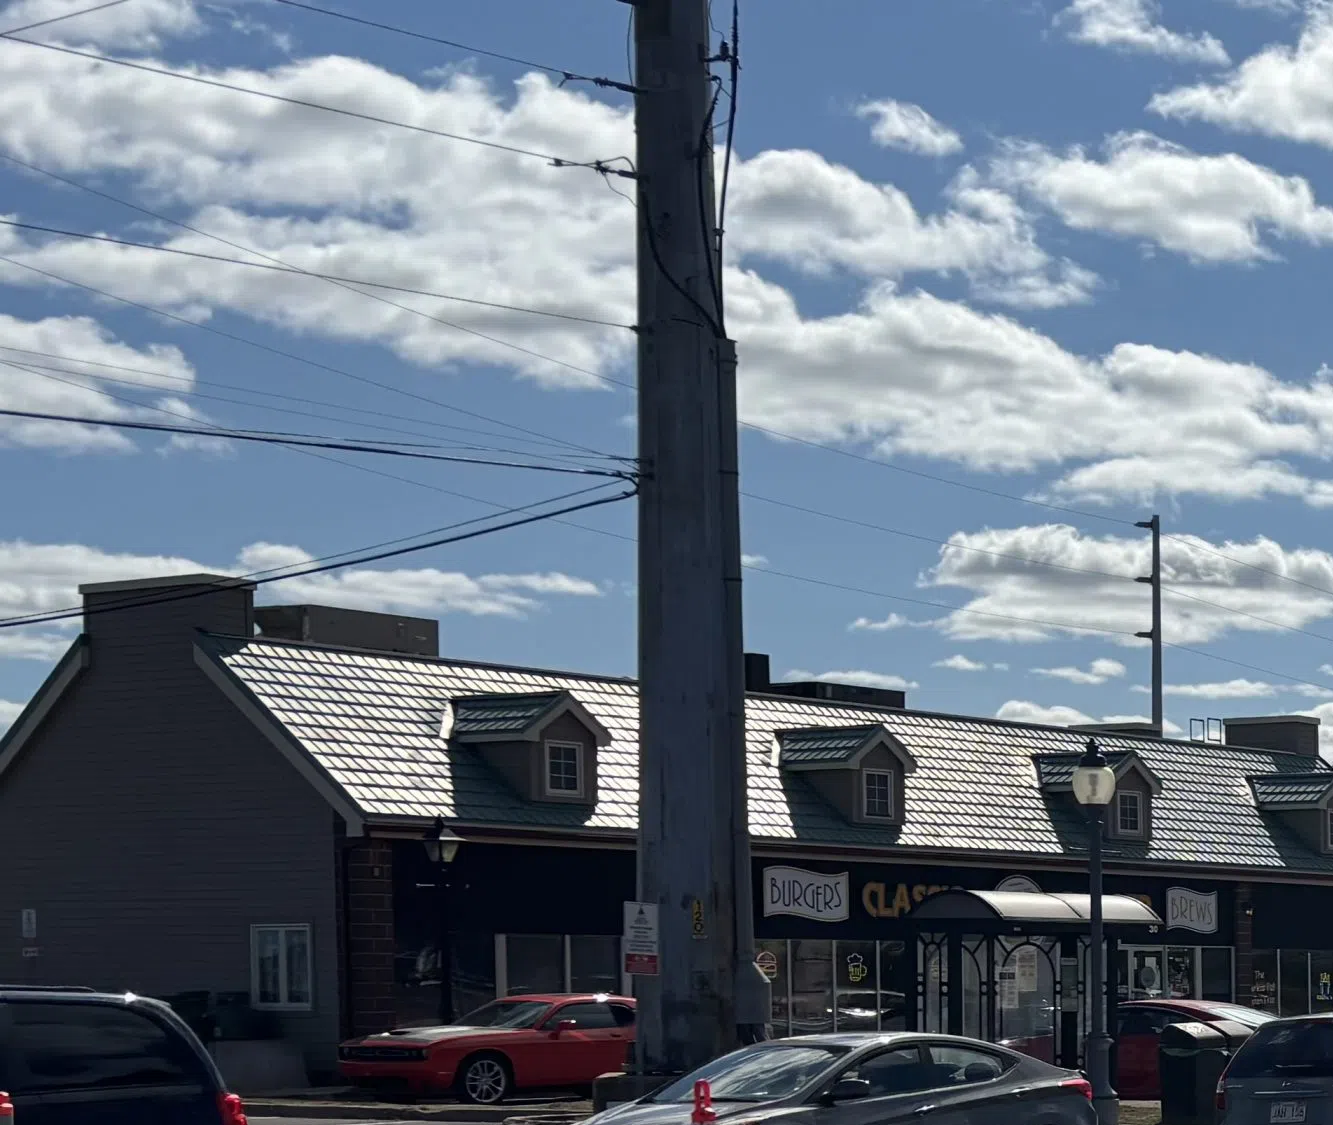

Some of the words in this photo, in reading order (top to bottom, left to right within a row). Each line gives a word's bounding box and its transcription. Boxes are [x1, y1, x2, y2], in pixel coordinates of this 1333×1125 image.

[770, 877, 842, 912] BURGERS
[862, 881, 964, 917] CLAS
[1170, 894, 1213, 925] BREWS
